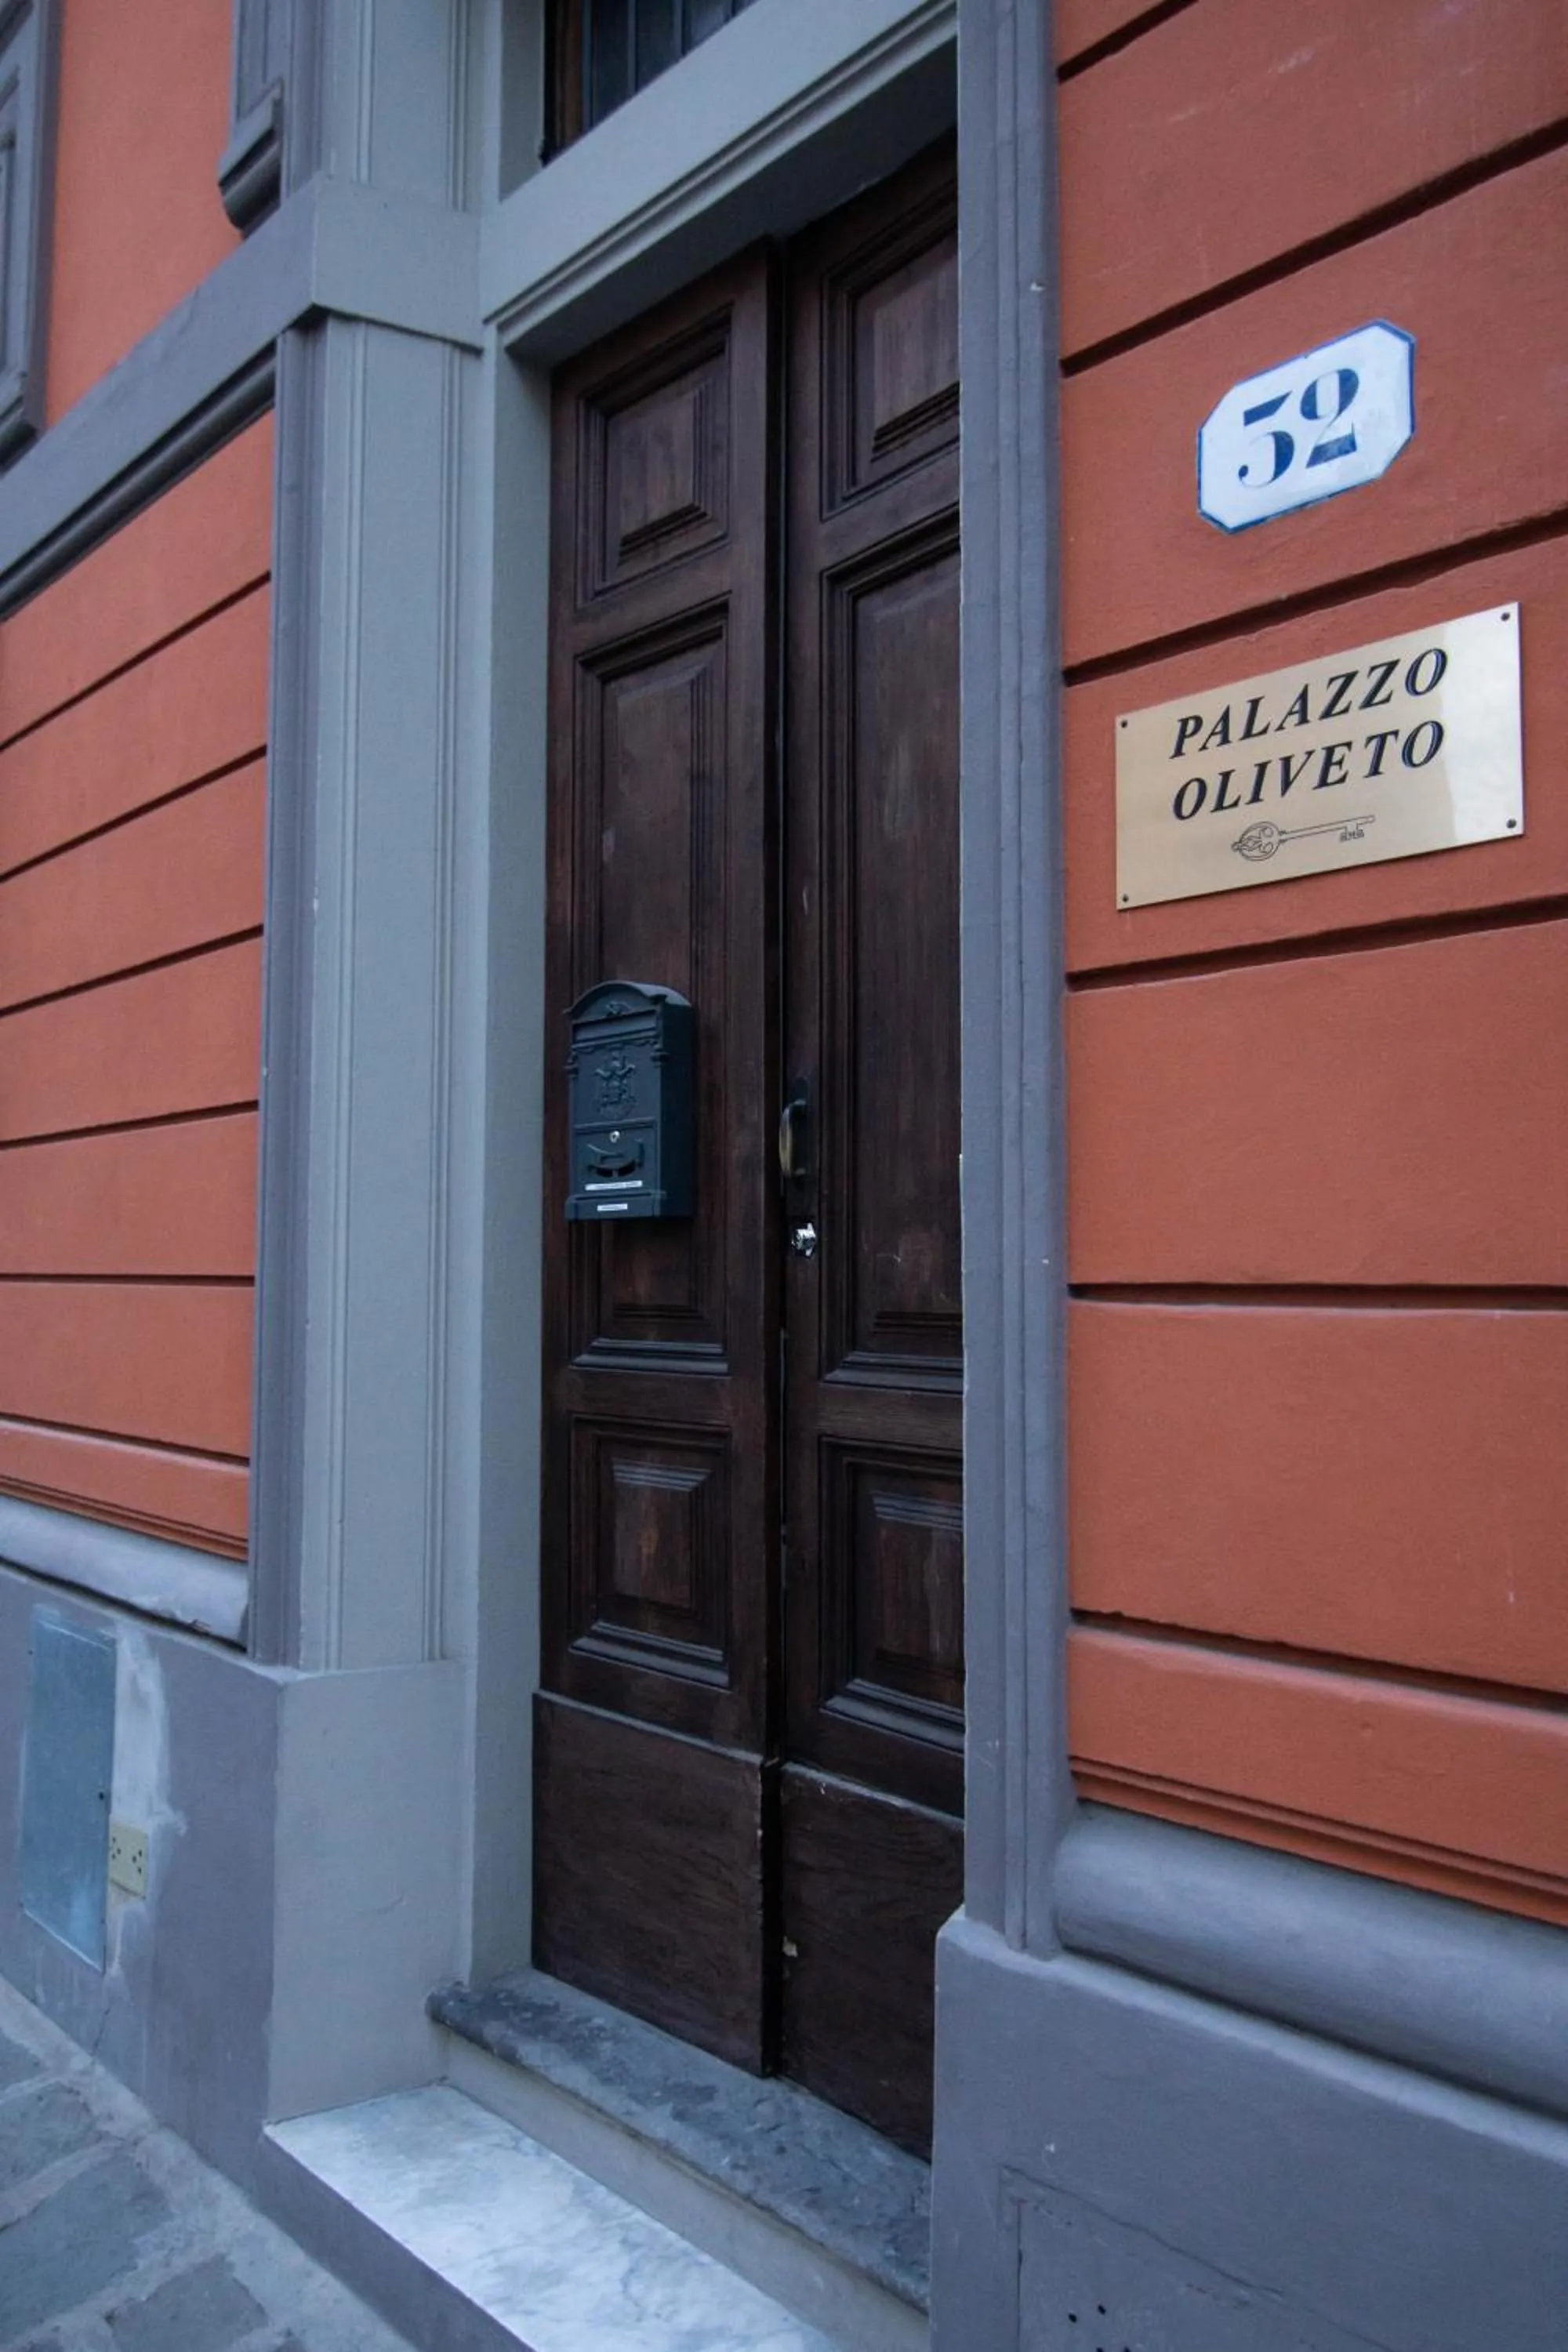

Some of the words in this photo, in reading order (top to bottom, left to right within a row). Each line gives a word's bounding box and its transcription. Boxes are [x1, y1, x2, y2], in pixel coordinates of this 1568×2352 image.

[1237, 367, 1360, 488] 52
[1169, 648, 1449, 760] PALAZZO
[1172, 720, 1445, 822] OLIVETO
